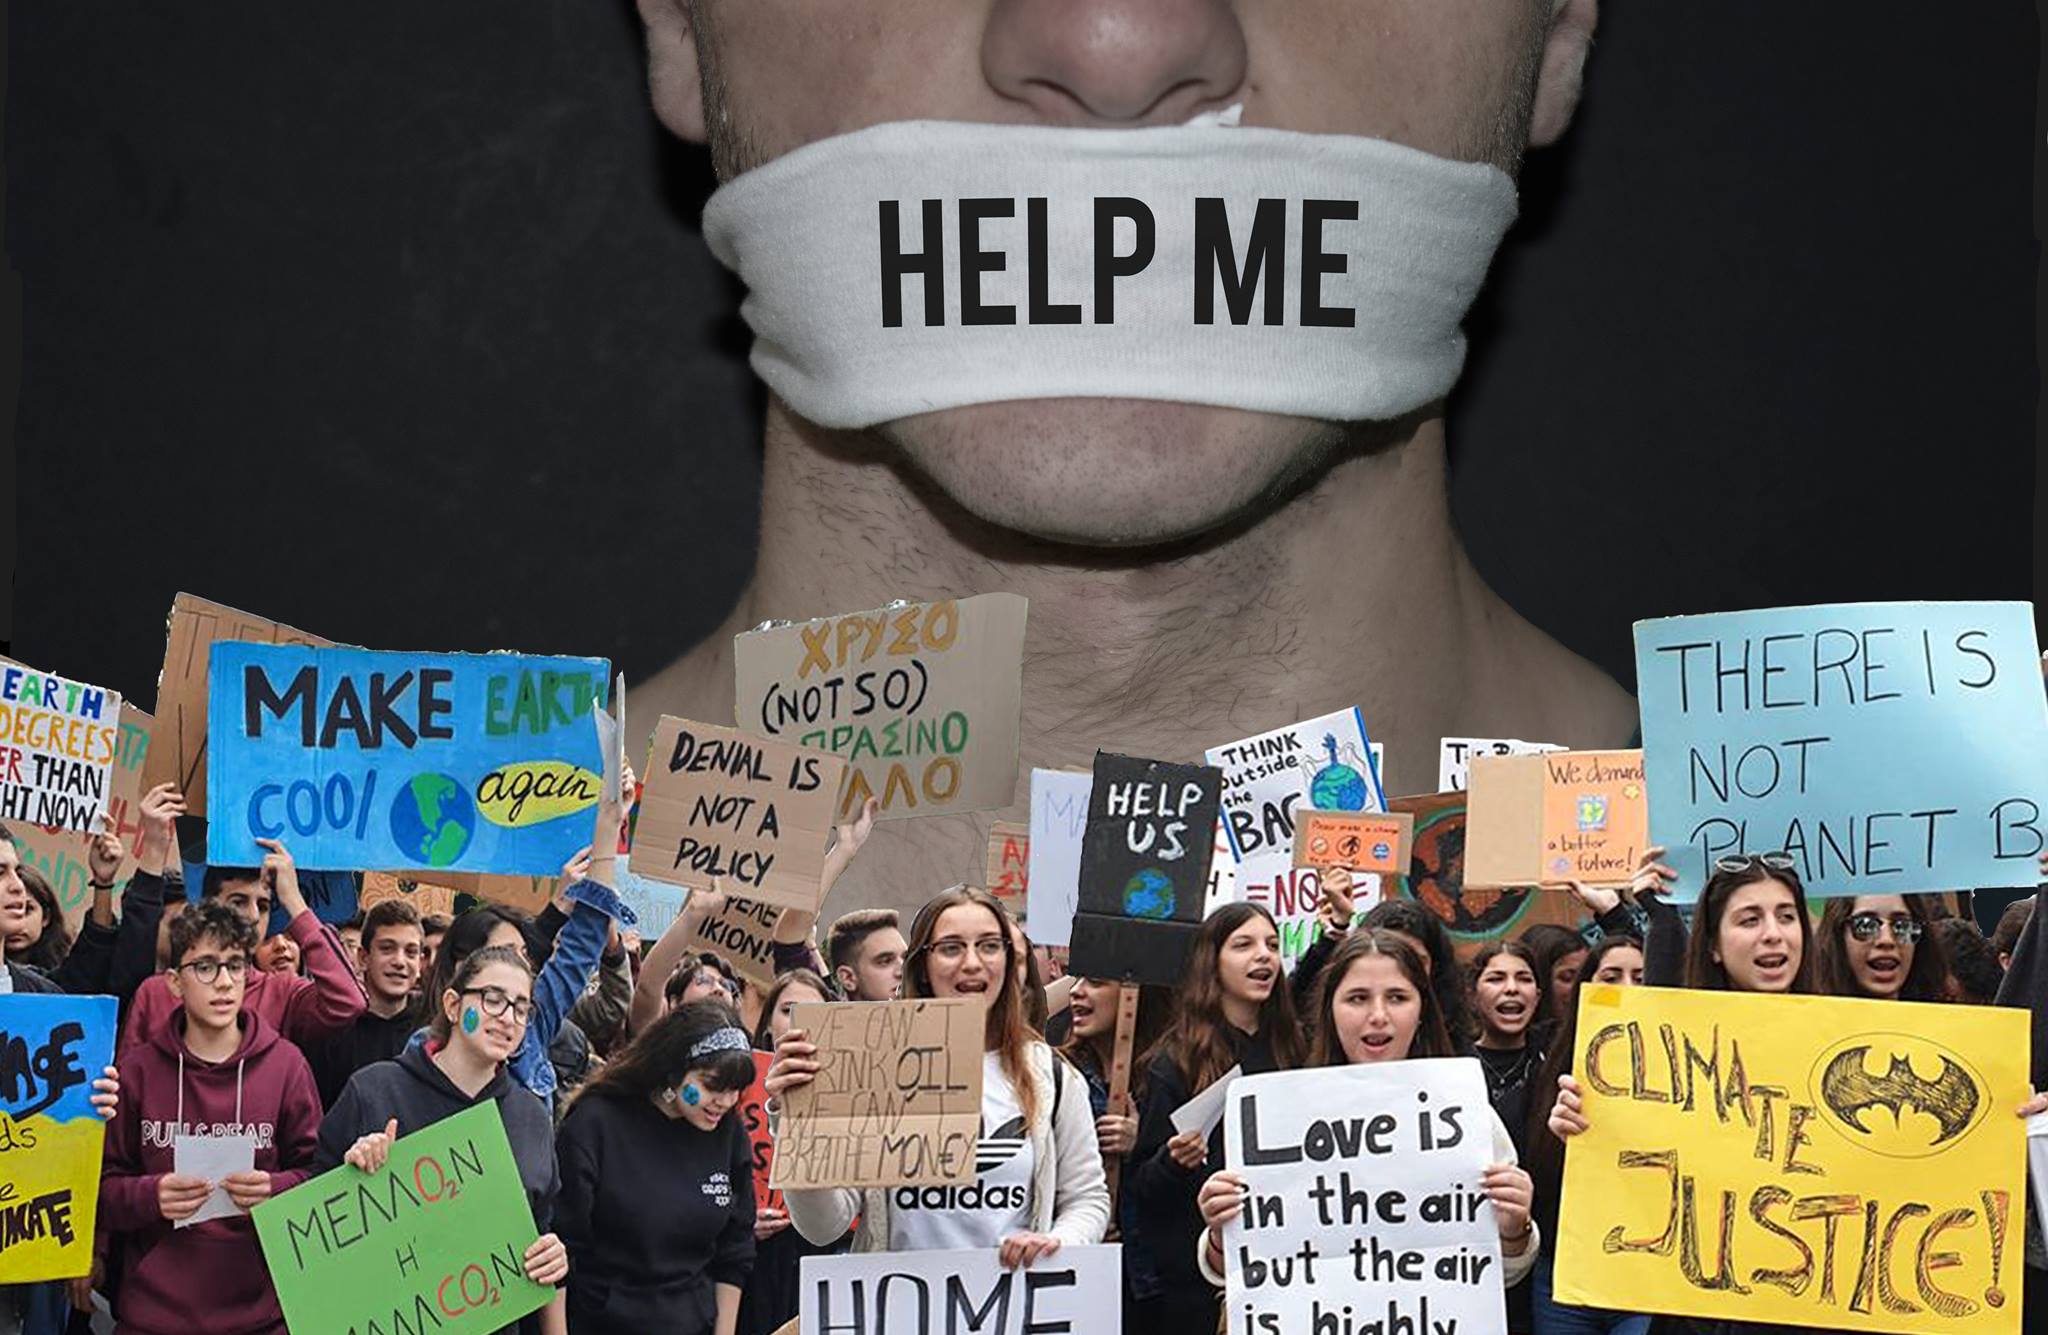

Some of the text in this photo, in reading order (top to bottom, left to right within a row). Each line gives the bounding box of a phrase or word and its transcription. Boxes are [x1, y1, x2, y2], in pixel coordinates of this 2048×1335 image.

[878, 197, 1359, 328] HELP ME
[3, 668, 104, 719] EARTH
[1656, 627, 1997, 713] THERE IS
[244, 664, 454, 749] MAKE
[762, 659, 928, 735] (NOT SO)
[0, 746, 103, 799] ER THAN
[669, 731, 821, 791] DENIAL IS
[1221, 731, 1303, 766] THINK
[1222, 753, 1299, 790] outside
[1548, 759, 1581, 785] We
[1690, 737, 1831, 805] NOT
[0, 782, 33, 821] HT
[36, 791, 97, 832] NOW
[476, 766, 597, 822] again
[689, 794, 779, 839] NOT A
[1107, 782, 1204, 818] HELP
[1224, 790, 1253, 809] the
[673, 837, 775, 888] POLICY
[1127, 821, 1189, 861] US
[1577, 846, 1634, 873] future!
[1690, 798, 2045, 883] PLANET B
[811, 1046, 969, 1093] RINK OIL
[1585, 1021, 1826, 1177] CLIMATE
[1240, 1091, 1465, 1166] Love is
[896, 1180, 1026, 1210] adidas
[1242, 1172, 1488, 1230] in the air
[1602, 1149, 2010, 1319] JUSTICE!
[1239, 1236, 1492, 1289] but the air
